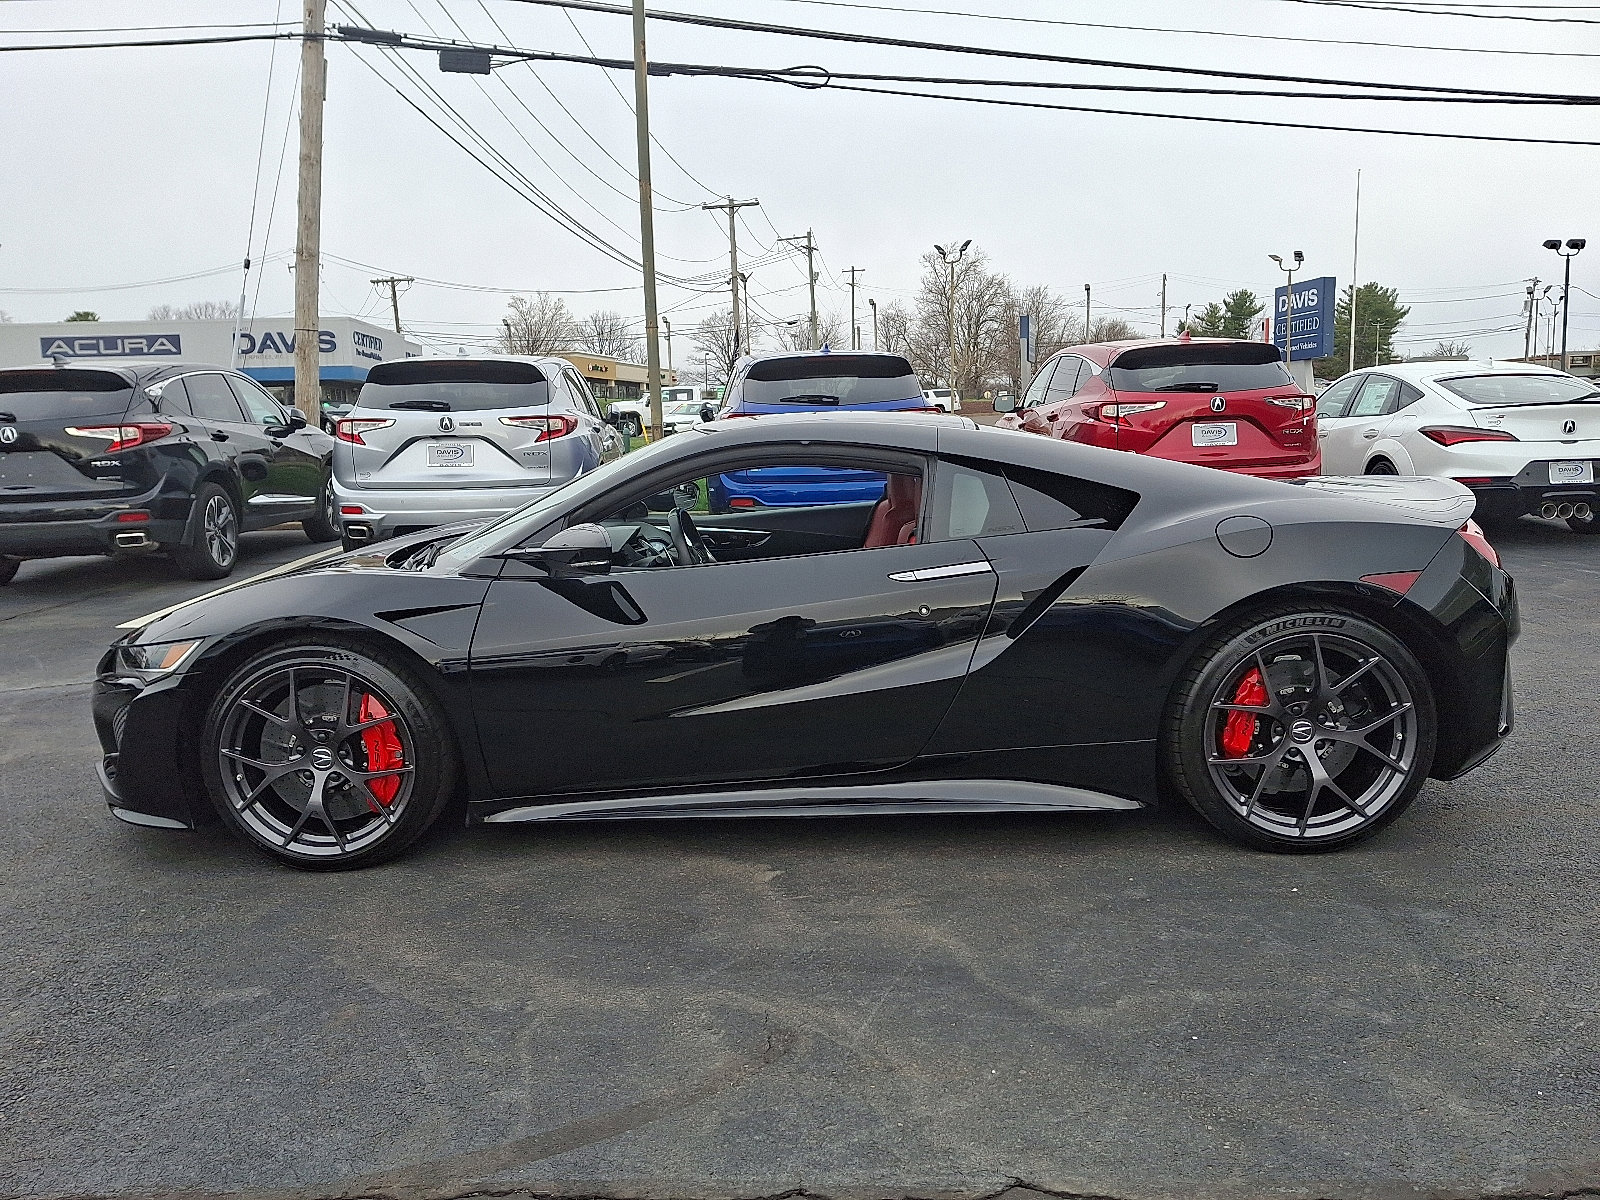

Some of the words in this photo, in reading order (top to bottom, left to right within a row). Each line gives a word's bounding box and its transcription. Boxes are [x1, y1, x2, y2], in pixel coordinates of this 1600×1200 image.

[1279, 288, 1318, 312] DAVIS
[1275, 316, 1320, 336] CETIFIED
[46, 337, 178, 355] ACURA
[232, 330, 337, 354] DAVS
[352, 330, 383, 352] CERTIFIED
[1265, 617, 1342, 635] MICHELIN
